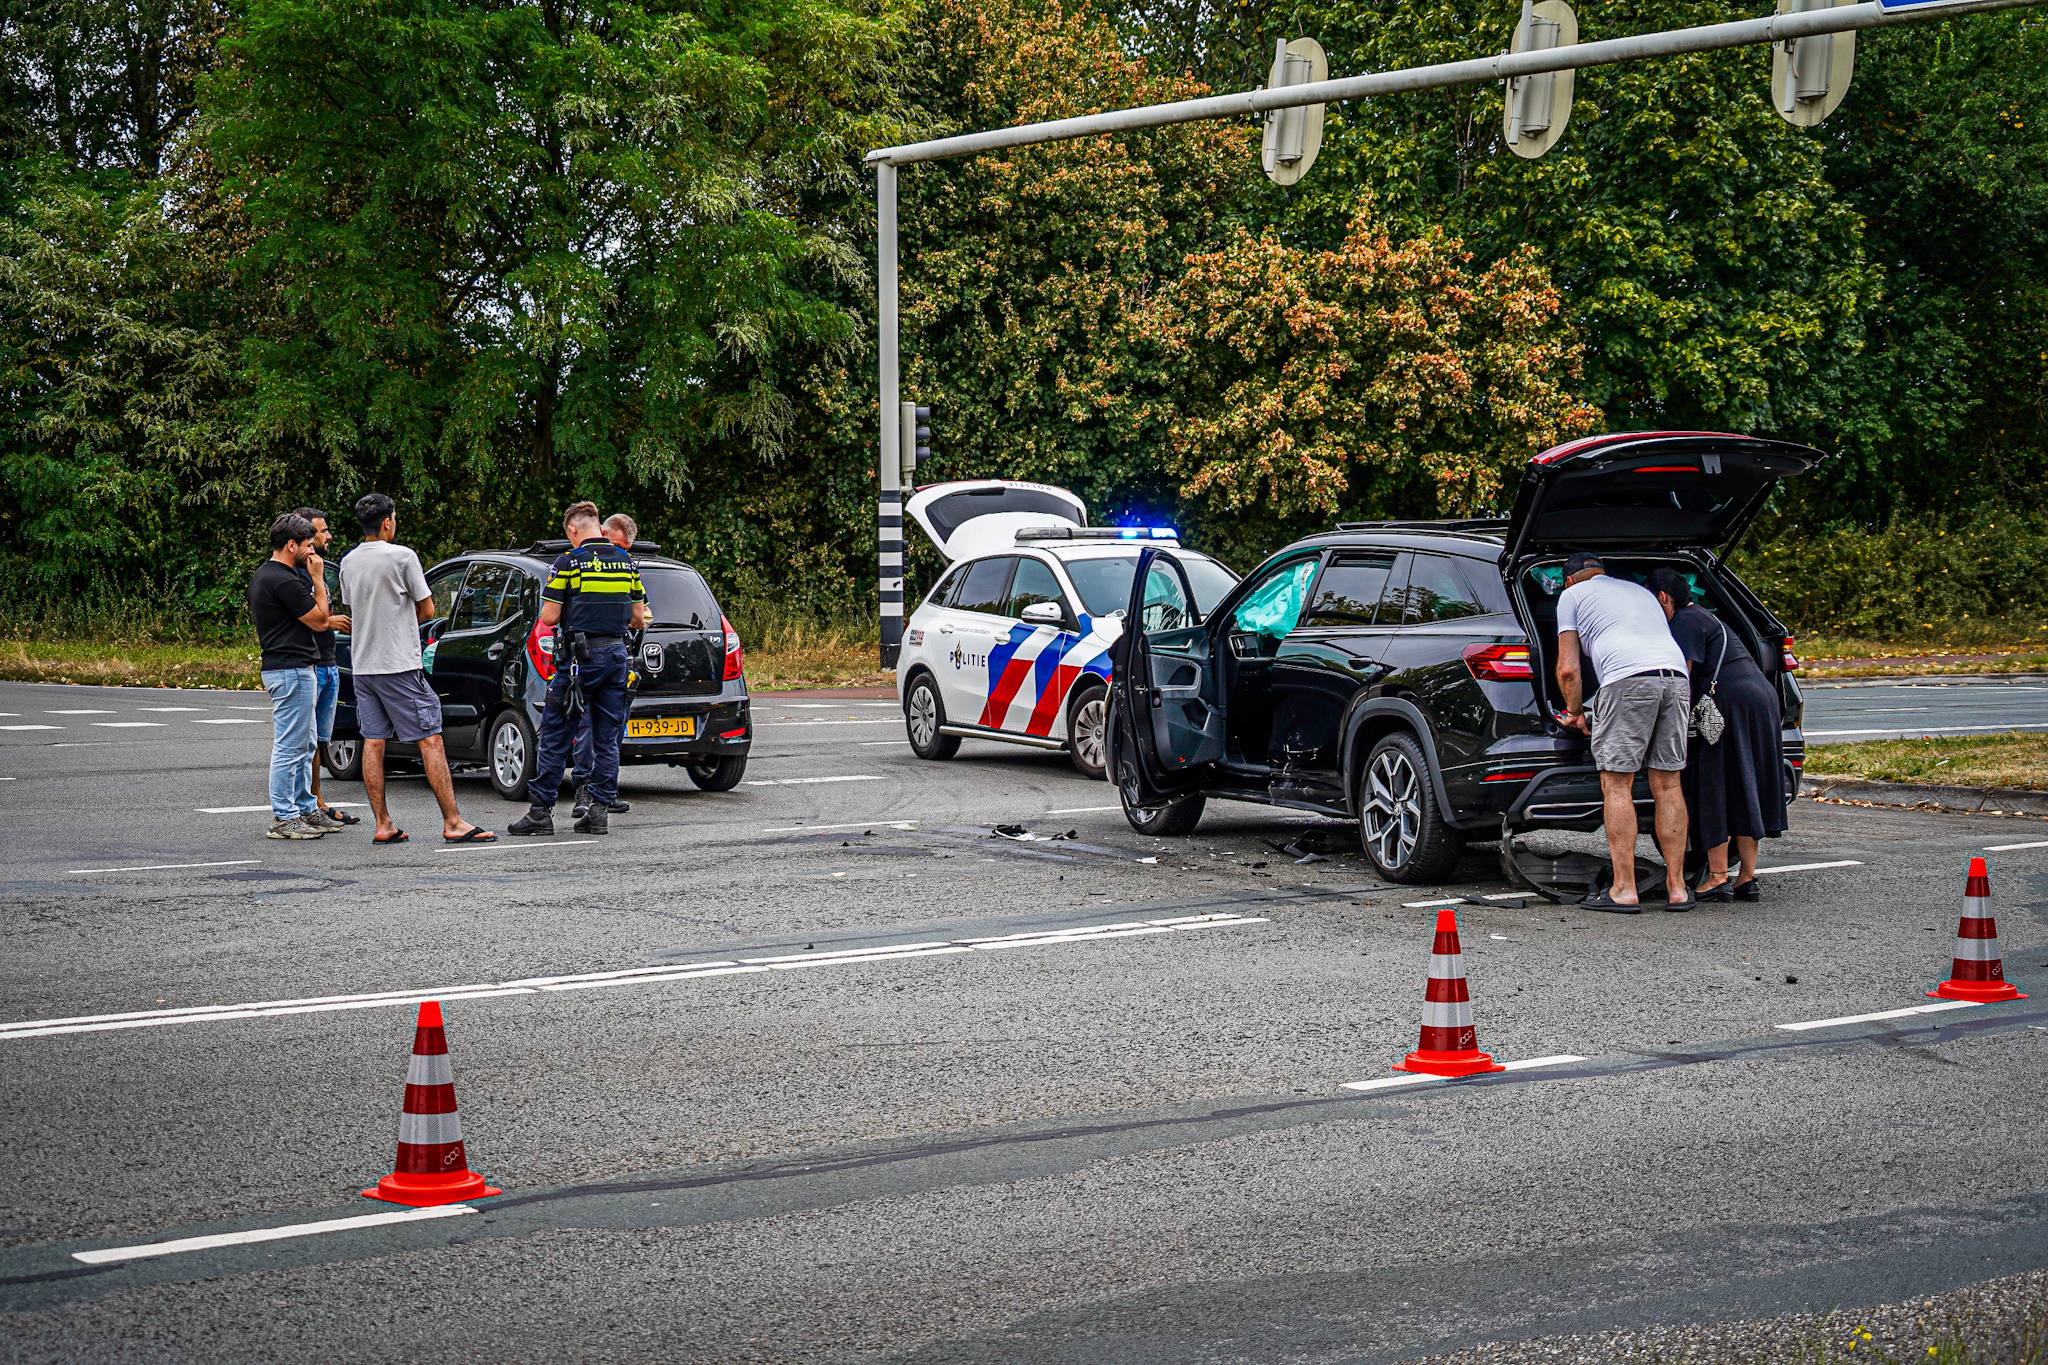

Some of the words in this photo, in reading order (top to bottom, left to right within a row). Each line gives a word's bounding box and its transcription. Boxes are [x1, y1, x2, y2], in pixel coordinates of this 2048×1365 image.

[587, 558, 626, 571] POLITIE
[949, 645, 986, 669] POLITIE
[631, 720, 689, 735] H-939-JD
